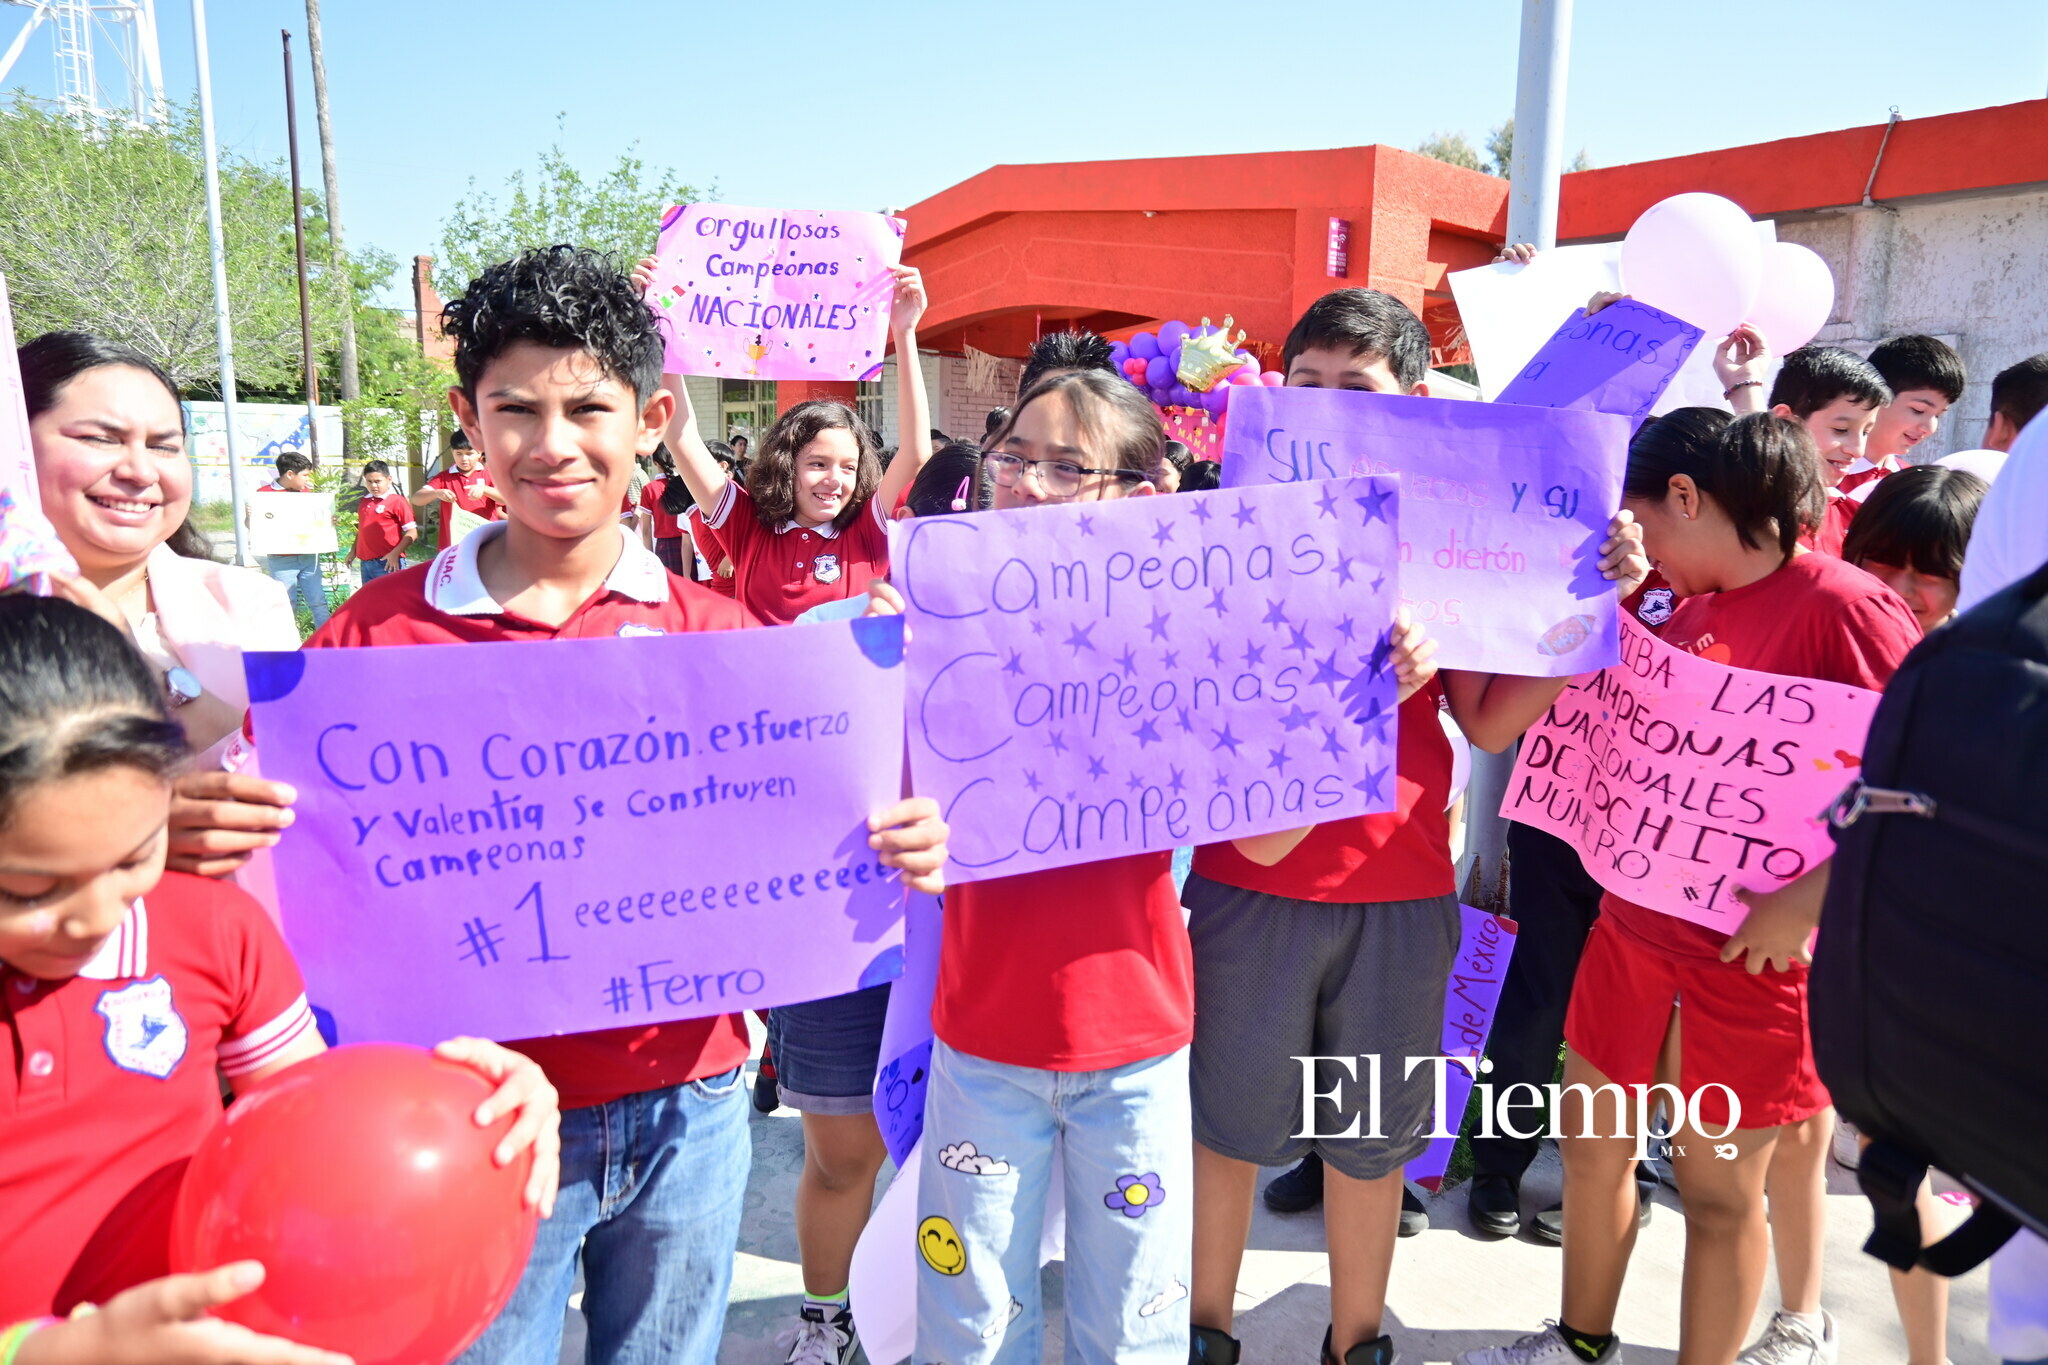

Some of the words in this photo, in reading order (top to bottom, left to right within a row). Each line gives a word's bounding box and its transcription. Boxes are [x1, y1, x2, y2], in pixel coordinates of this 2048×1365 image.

[689, 293, 857, 330] NACIONALES
[1553, 322, 1663, 364] eonas
[905, 519, 1325, 618] Campeonas
[921, 652, 1303, 763] Campeonas
[1620, 622, 1676, 690] RIBA
[1710, 672, 1815, 725] LAS
[317, 722, 451, 792] Con
[709, 709, 851, 754] esfuerzo
[1544, 704, 1766, 825] NACIONALES
[1567, 668, 1800, 777] AMPEONAS
[944, 773, 1345, 868] Campeonas
[1514, 775, 1652, 880] NÚMERO
[1526, 735, 1576, 780] DE
[1584, 753, 1805, 881] TOCHITO
[602, 959, 766, 1015] #Ferro
[1453, 918, 1499, 1012] México
[1450, 1013, 1485, 1045] de
